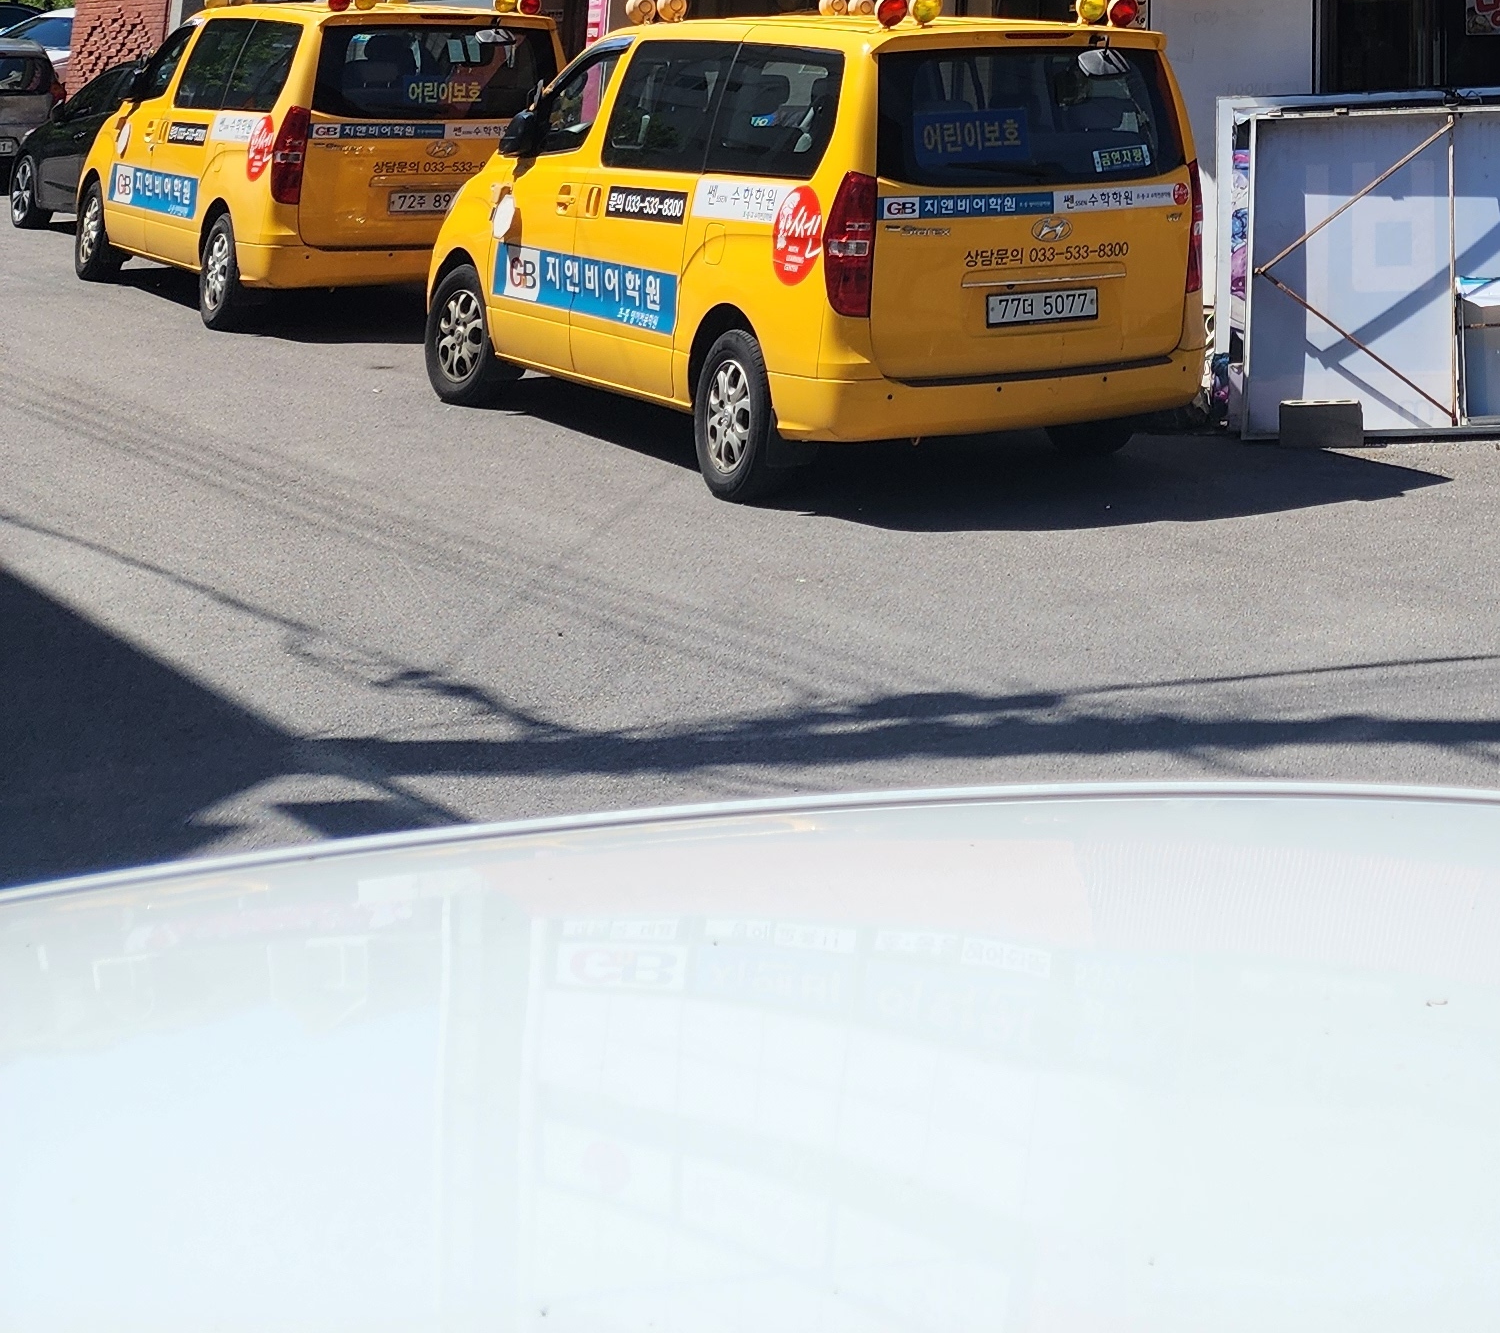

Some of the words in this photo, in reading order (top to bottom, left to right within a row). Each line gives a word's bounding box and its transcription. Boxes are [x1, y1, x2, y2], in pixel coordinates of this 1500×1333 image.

[409, 82, 482, 103] 어린이보호
[344, 125, 415, 136] 지앤비어학원
[923, 119, 1021, 153] 어린이보호
[373, 162, 419, 173] 상담문의
[423, 162, 485, 172] 033-533-8
[1101, 148, 1142, 166] 금연차량
[399, 195, 425, 209] 72주
[609, 192, 623, 212] 문의
[625, 195, 683, 216] 033-533-8300
[731, 187, 777, 211] 수학학원
[925, 197, 1016, 214] 지앤비어학원
[1089, 190, 1133, 207] 수학학원
[964, 248, 1024, 266] 상담문의
[1029, 242, 1128, 262] 033-533-8300
[547, 256, 660, 311] 지앤비어학원
[999, 298, 1034, 318] 77더
[1043, 293, 1088, 315] 5077
